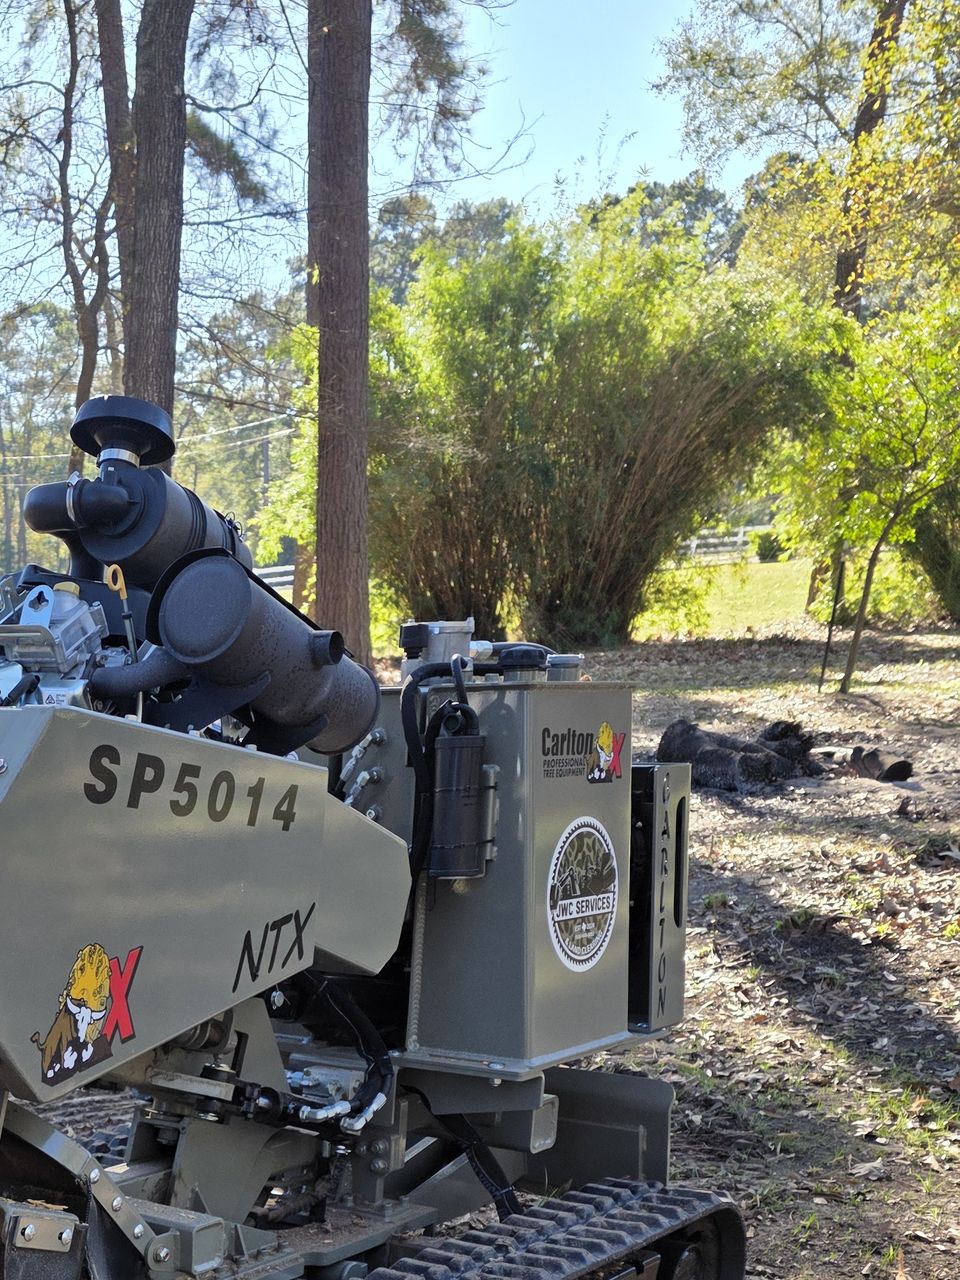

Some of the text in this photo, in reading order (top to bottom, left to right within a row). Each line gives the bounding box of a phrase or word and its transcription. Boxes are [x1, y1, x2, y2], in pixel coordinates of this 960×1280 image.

[542, 727, 594, 757] Carlton
[542, 757, 587, 769] PROFESSIONAL
[543, 767, 586, 779] TREE EQUIPMENT
[83, 744, 299, 832] SP5014
[556, 895, 611, 918] JWC SERVICES
[657, 771, 670, 1019] CARLTON
[232, 902, 316, 994] NTX
